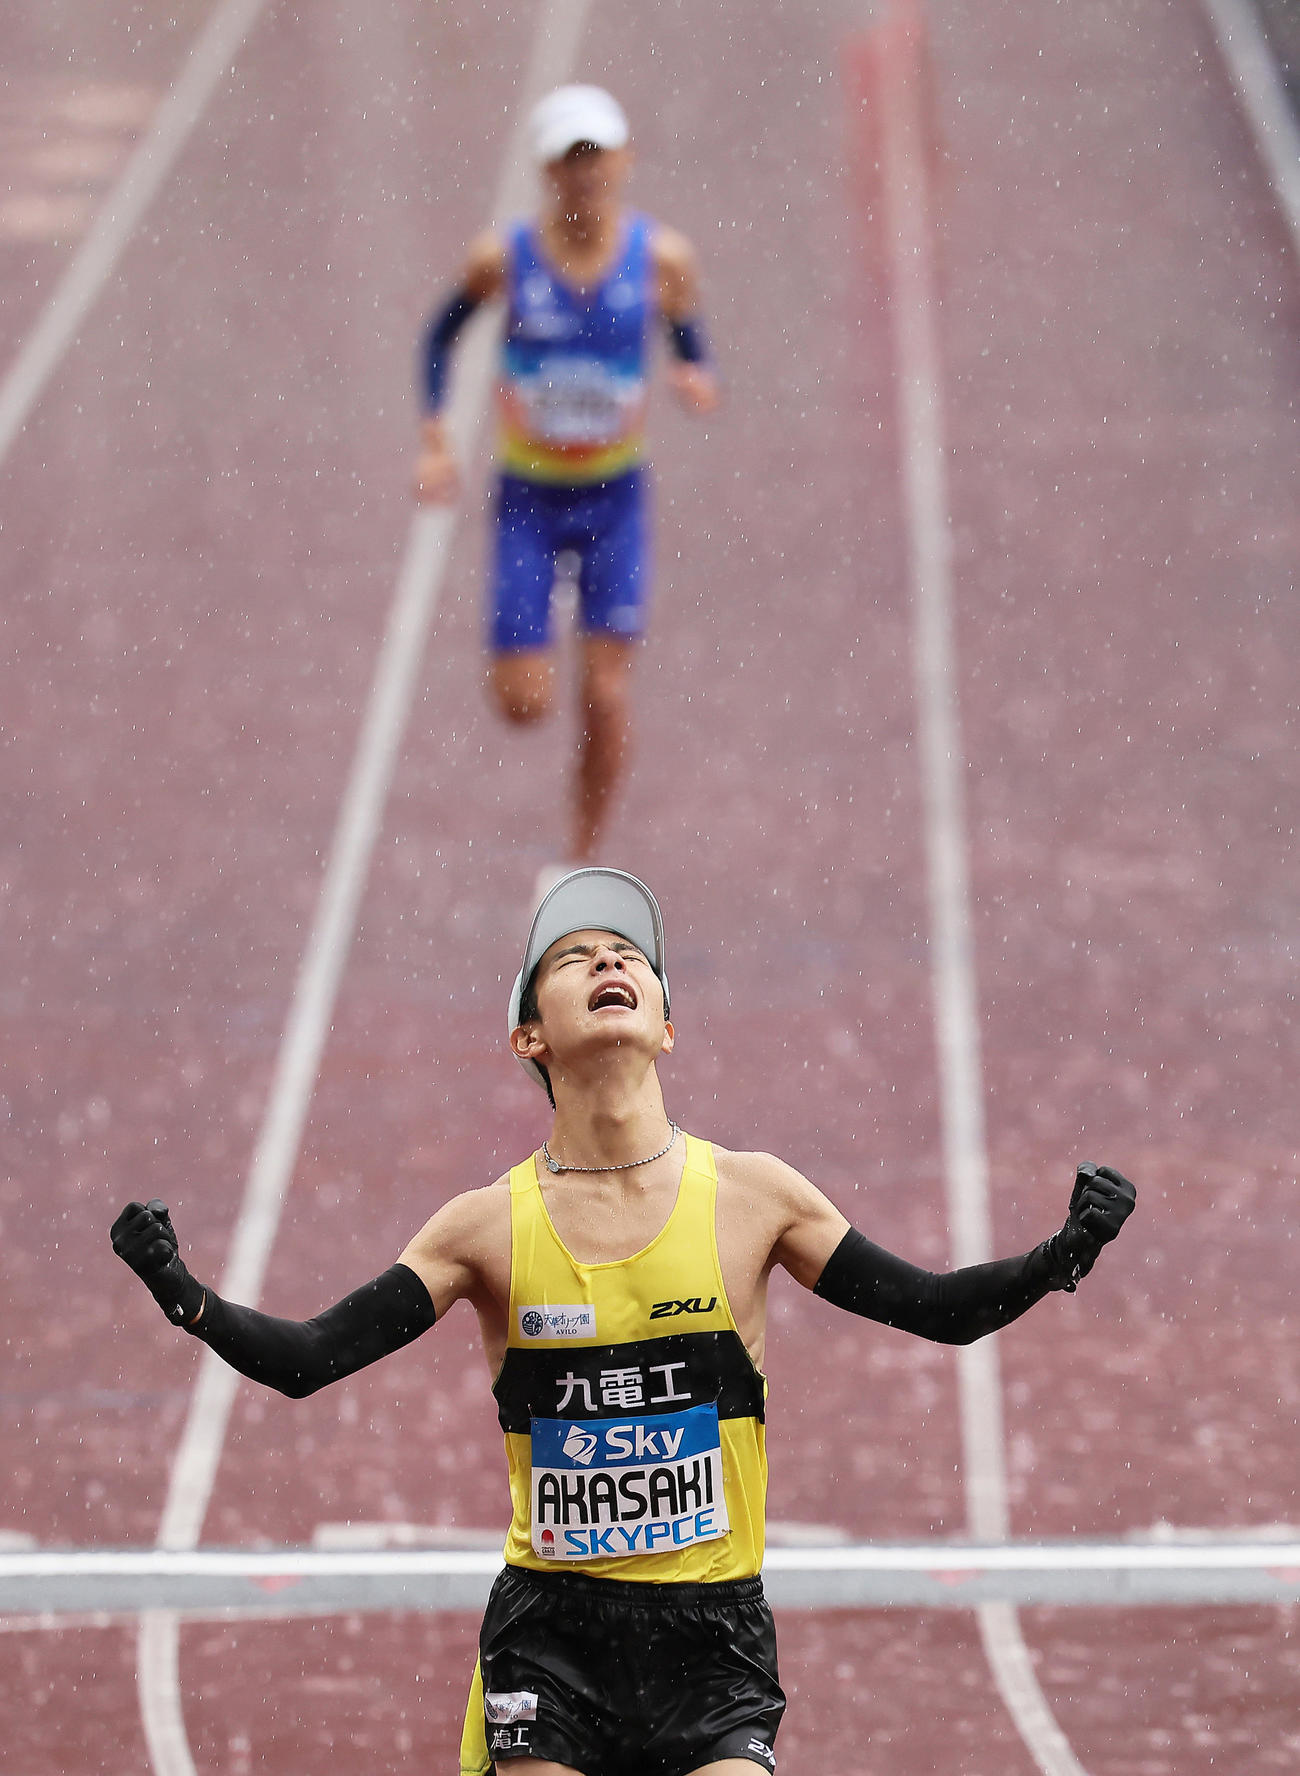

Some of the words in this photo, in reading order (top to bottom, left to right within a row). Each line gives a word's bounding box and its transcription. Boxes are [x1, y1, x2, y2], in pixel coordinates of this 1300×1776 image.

[650, 1297, 717, 1320] 2XU
[556, 1361, 691, 1412] 九電工
[605, 1424, 685, 1460] Sky
[538, 1456, 713, 1525] AKASAKI
[563, 1508, 718, 1556] SKYPCE
